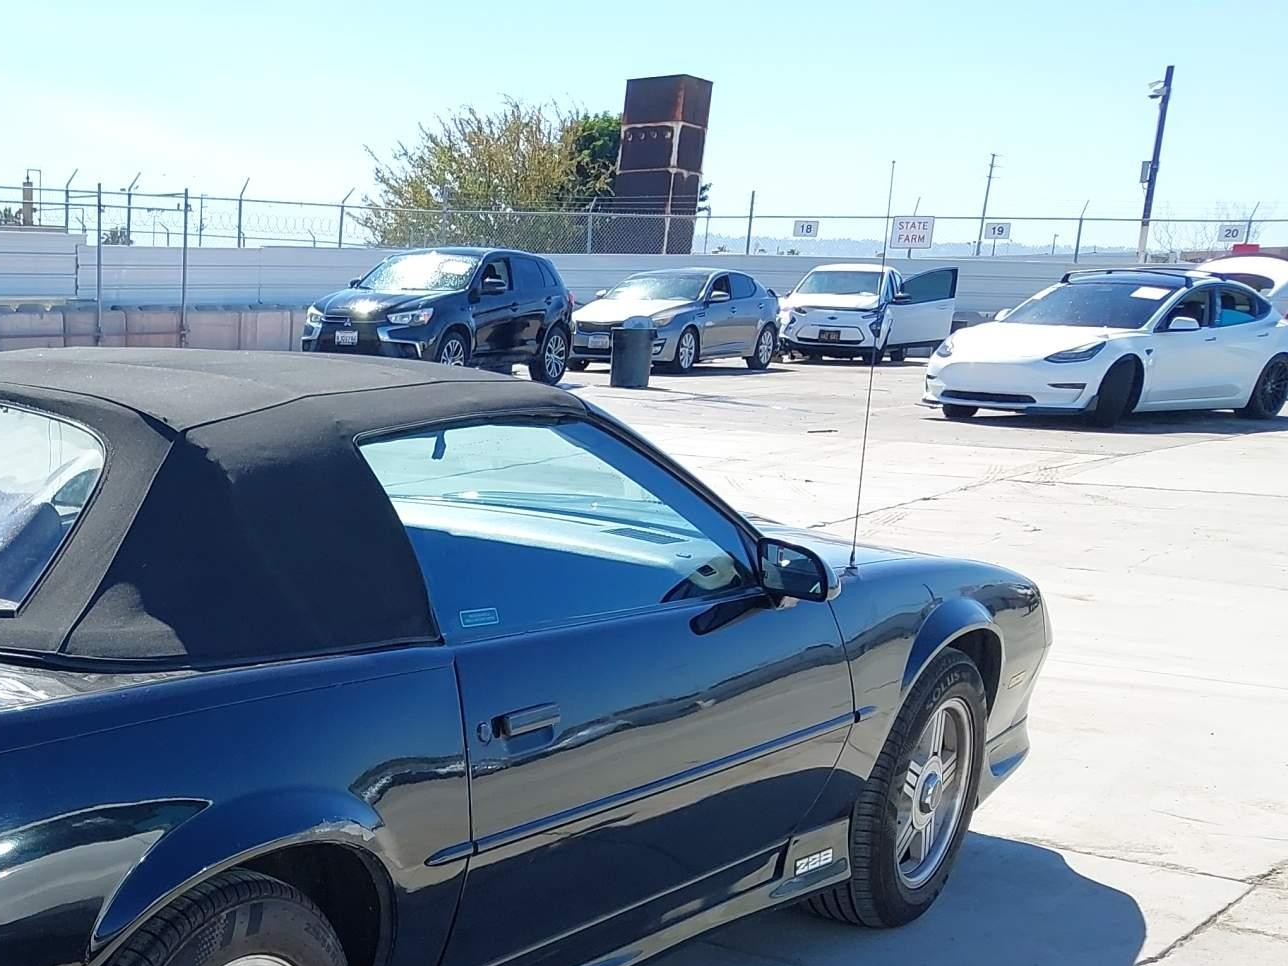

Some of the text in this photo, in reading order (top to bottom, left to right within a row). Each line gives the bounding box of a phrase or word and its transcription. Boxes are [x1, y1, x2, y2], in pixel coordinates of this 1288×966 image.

[800, 224, 813, 234] 18
[898, 221, 929, 230] STATE
[991, 226, 1004, 236] 19
[1224, 228, 1239, 238] 20
[897, 234, 926, 243] FARM
[795, 848, 833, 876] Z28
